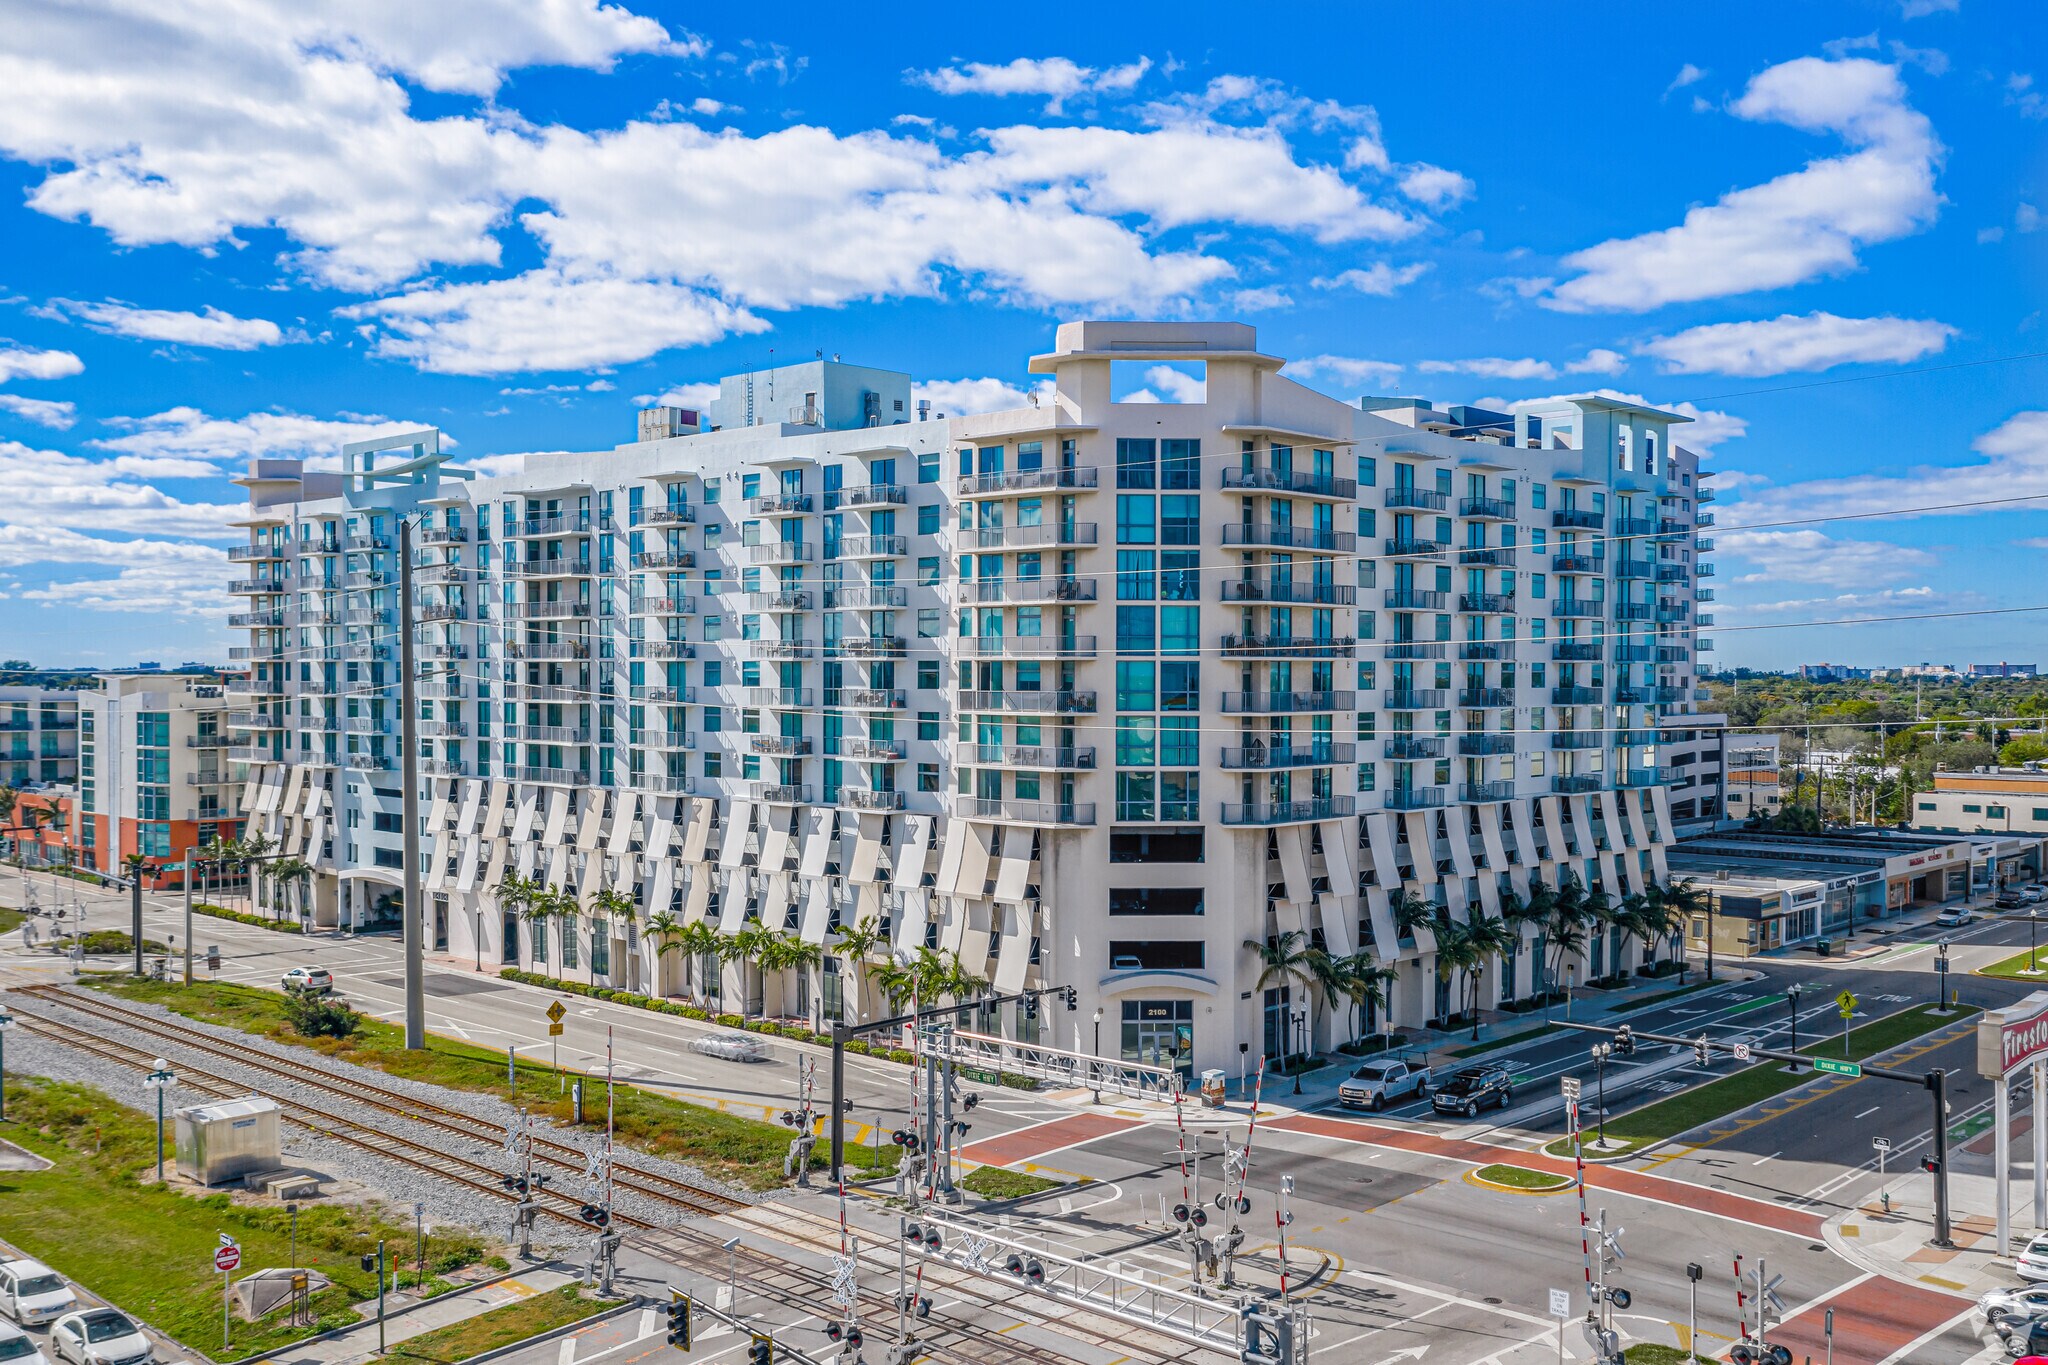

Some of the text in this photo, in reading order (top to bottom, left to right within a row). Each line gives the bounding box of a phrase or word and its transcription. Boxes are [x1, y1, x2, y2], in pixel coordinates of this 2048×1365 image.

[1821, 1062, 1836, 1070] DIXIE
[967, 1070, 994, 1083] DIXIE HWY
[962, 1238, 987, 1267] CROSSING
[833, 1261, 855, 1287] CROSSING
